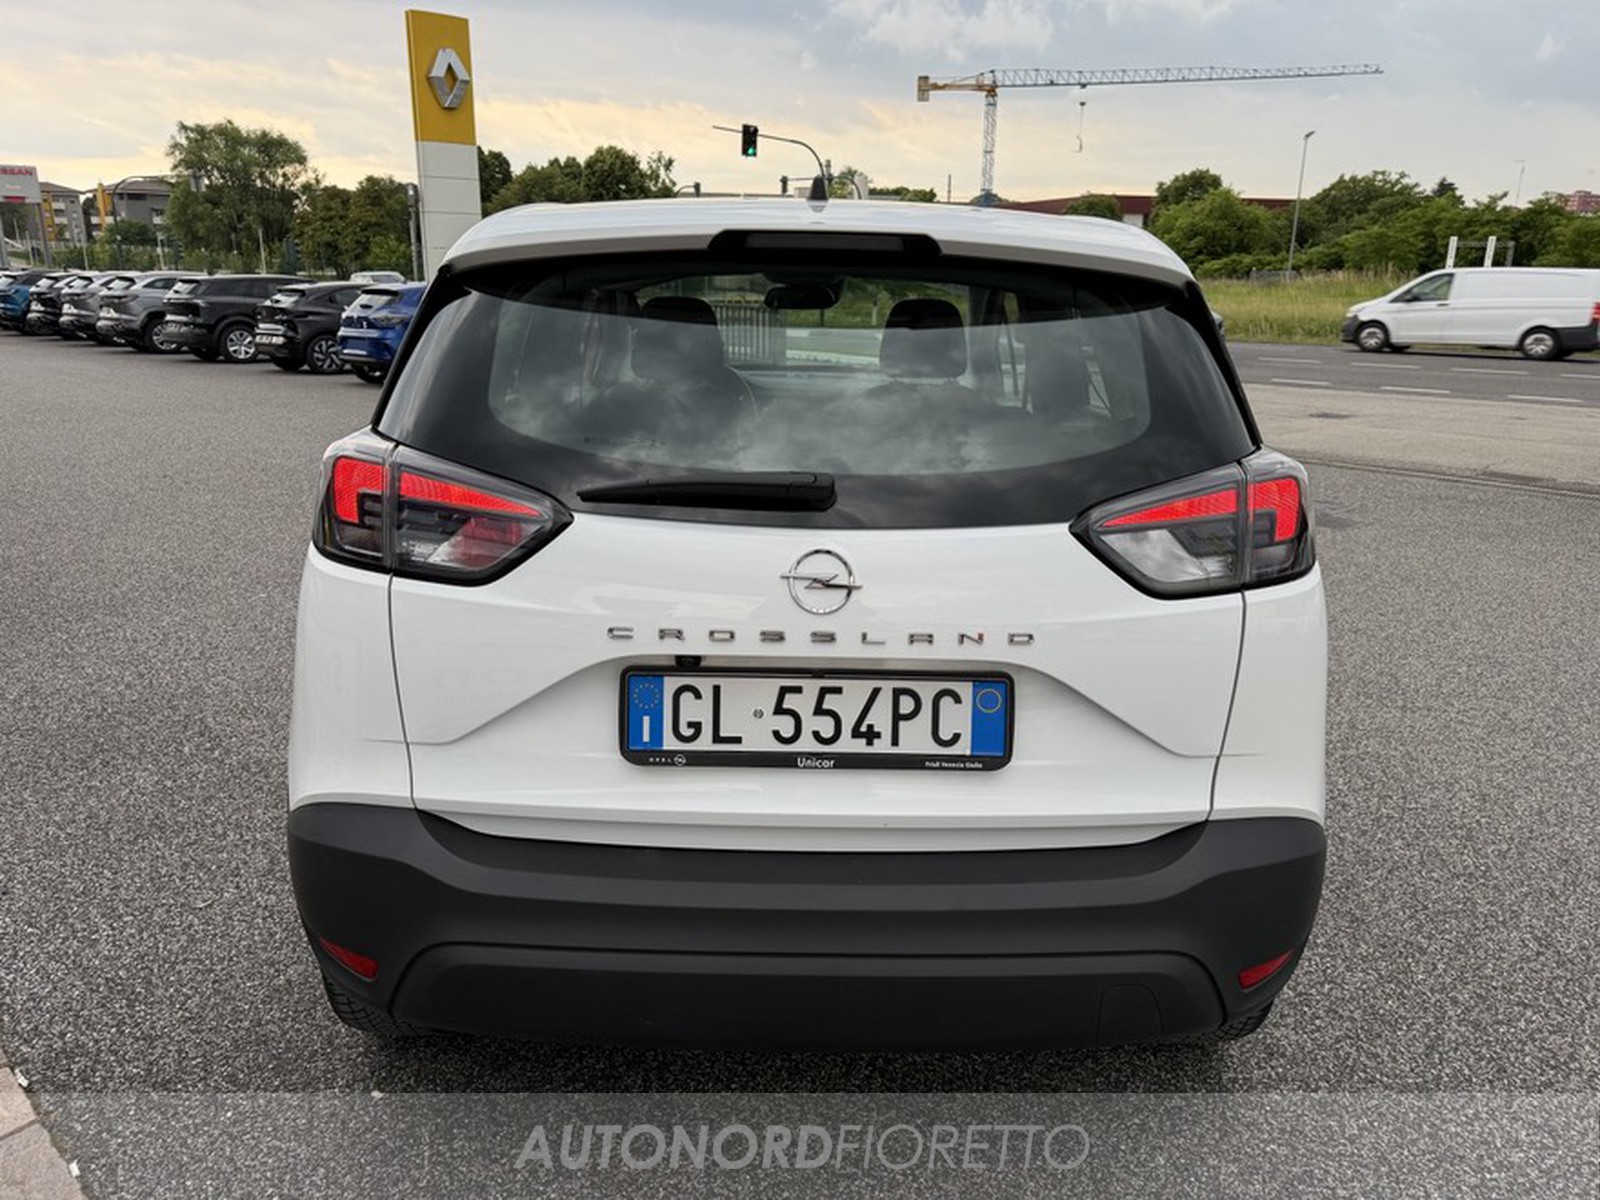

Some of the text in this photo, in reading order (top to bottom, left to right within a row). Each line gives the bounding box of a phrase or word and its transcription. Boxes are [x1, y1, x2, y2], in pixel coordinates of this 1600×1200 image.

[607, 627, 1035, 645] CROSSLAND
[672, 684, 963, 748] GL 554PC
[797, 756, 835, 768] Unicor
